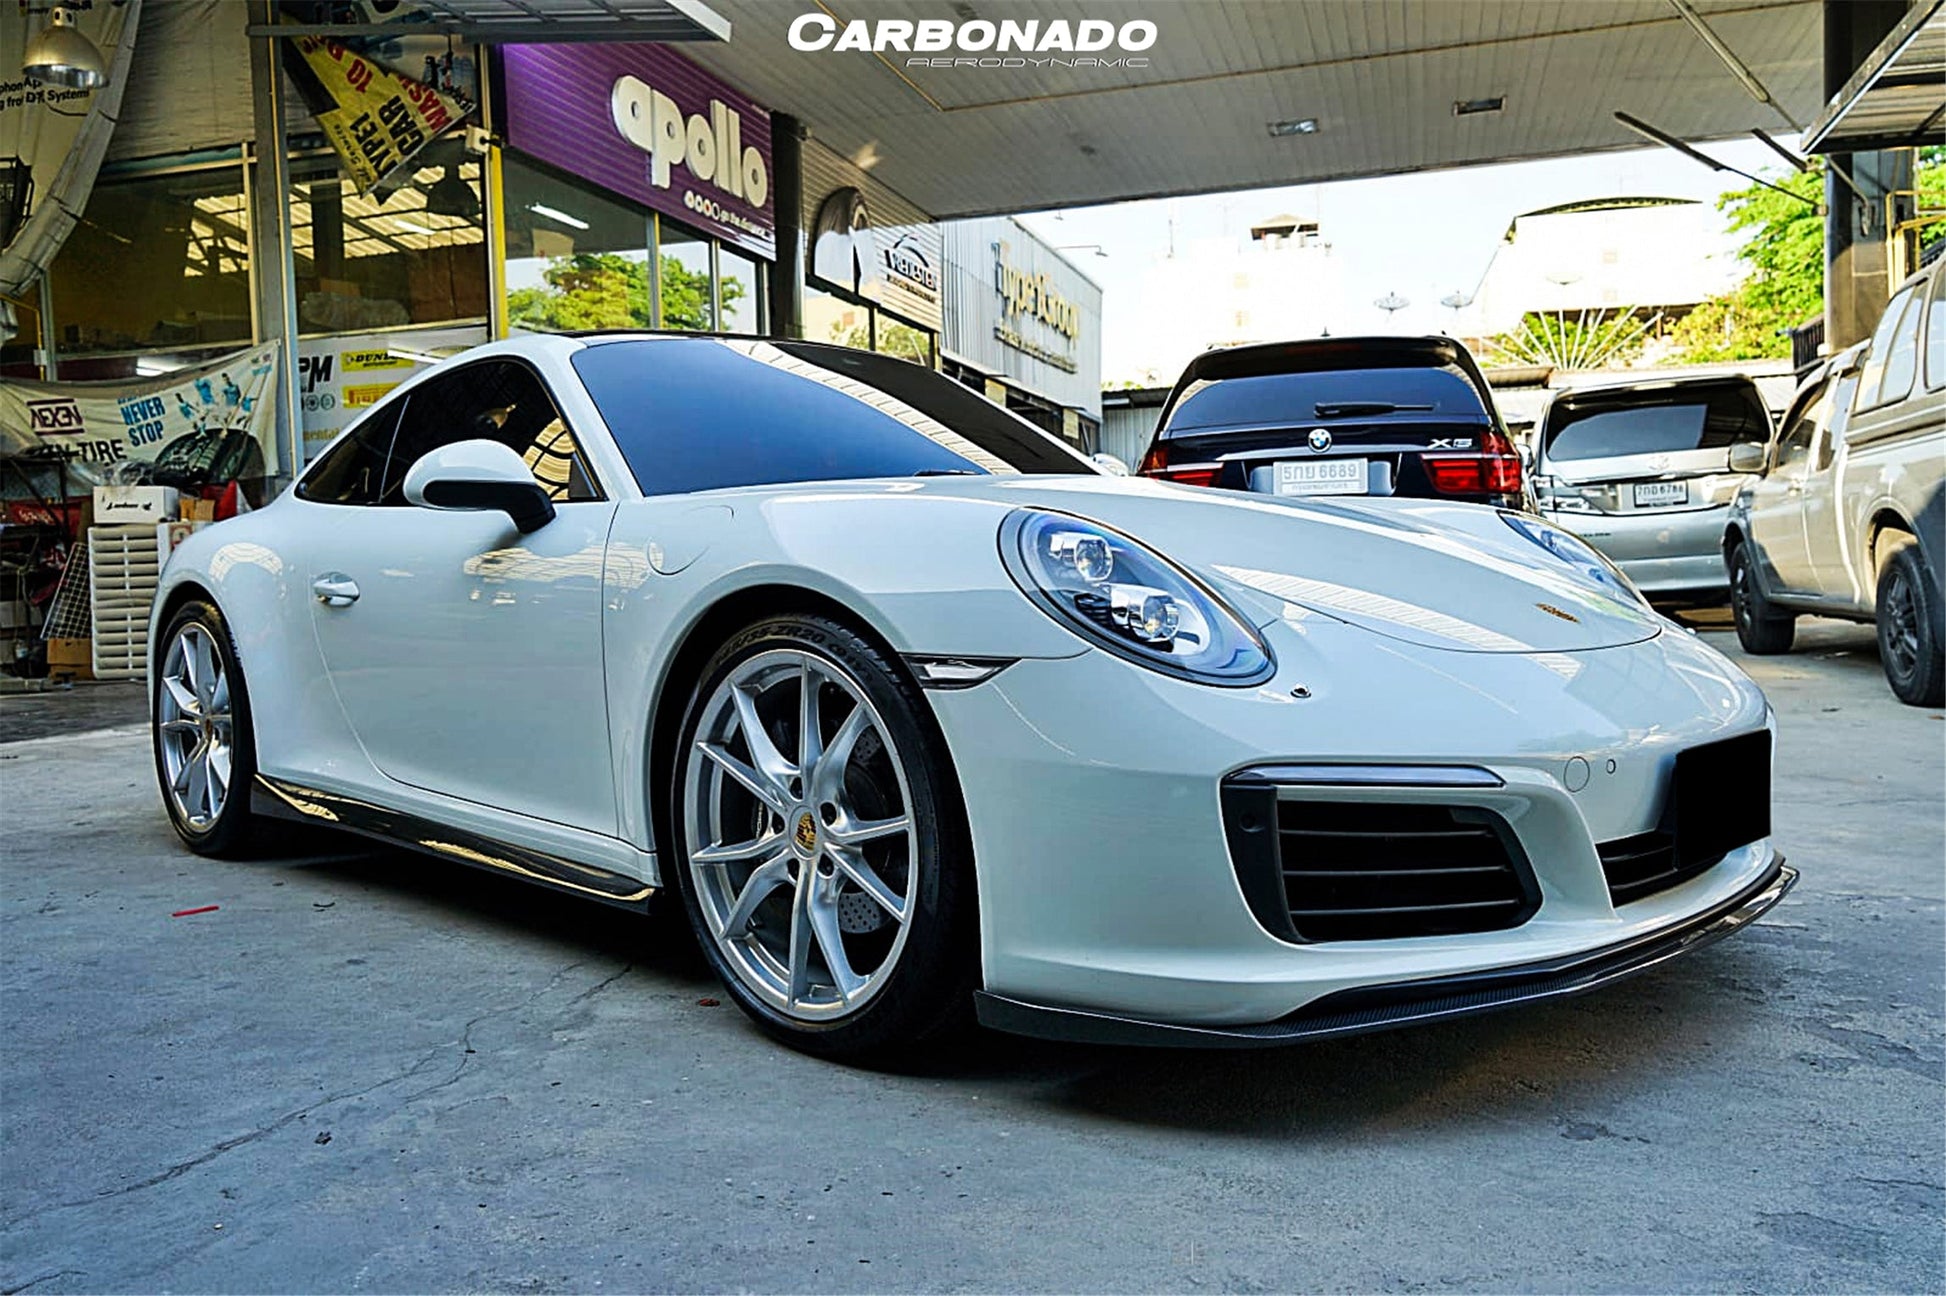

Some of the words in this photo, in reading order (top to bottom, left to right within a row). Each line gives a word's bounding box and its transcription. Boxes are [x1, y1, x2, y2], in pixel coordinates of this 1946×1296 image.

[378, 95, 425, 156] CAR
[612, 75, 768, 208] apollo
[355, 352, 404, 362] DUNL
[30, 404, 84, 430] NEXEN
[120, 396, 166, 426] NEVER
[128, 420, 164, 447] STOP
[1428, 438, 1473, 449] X5
[76, 438, 127, 467] TIRE
